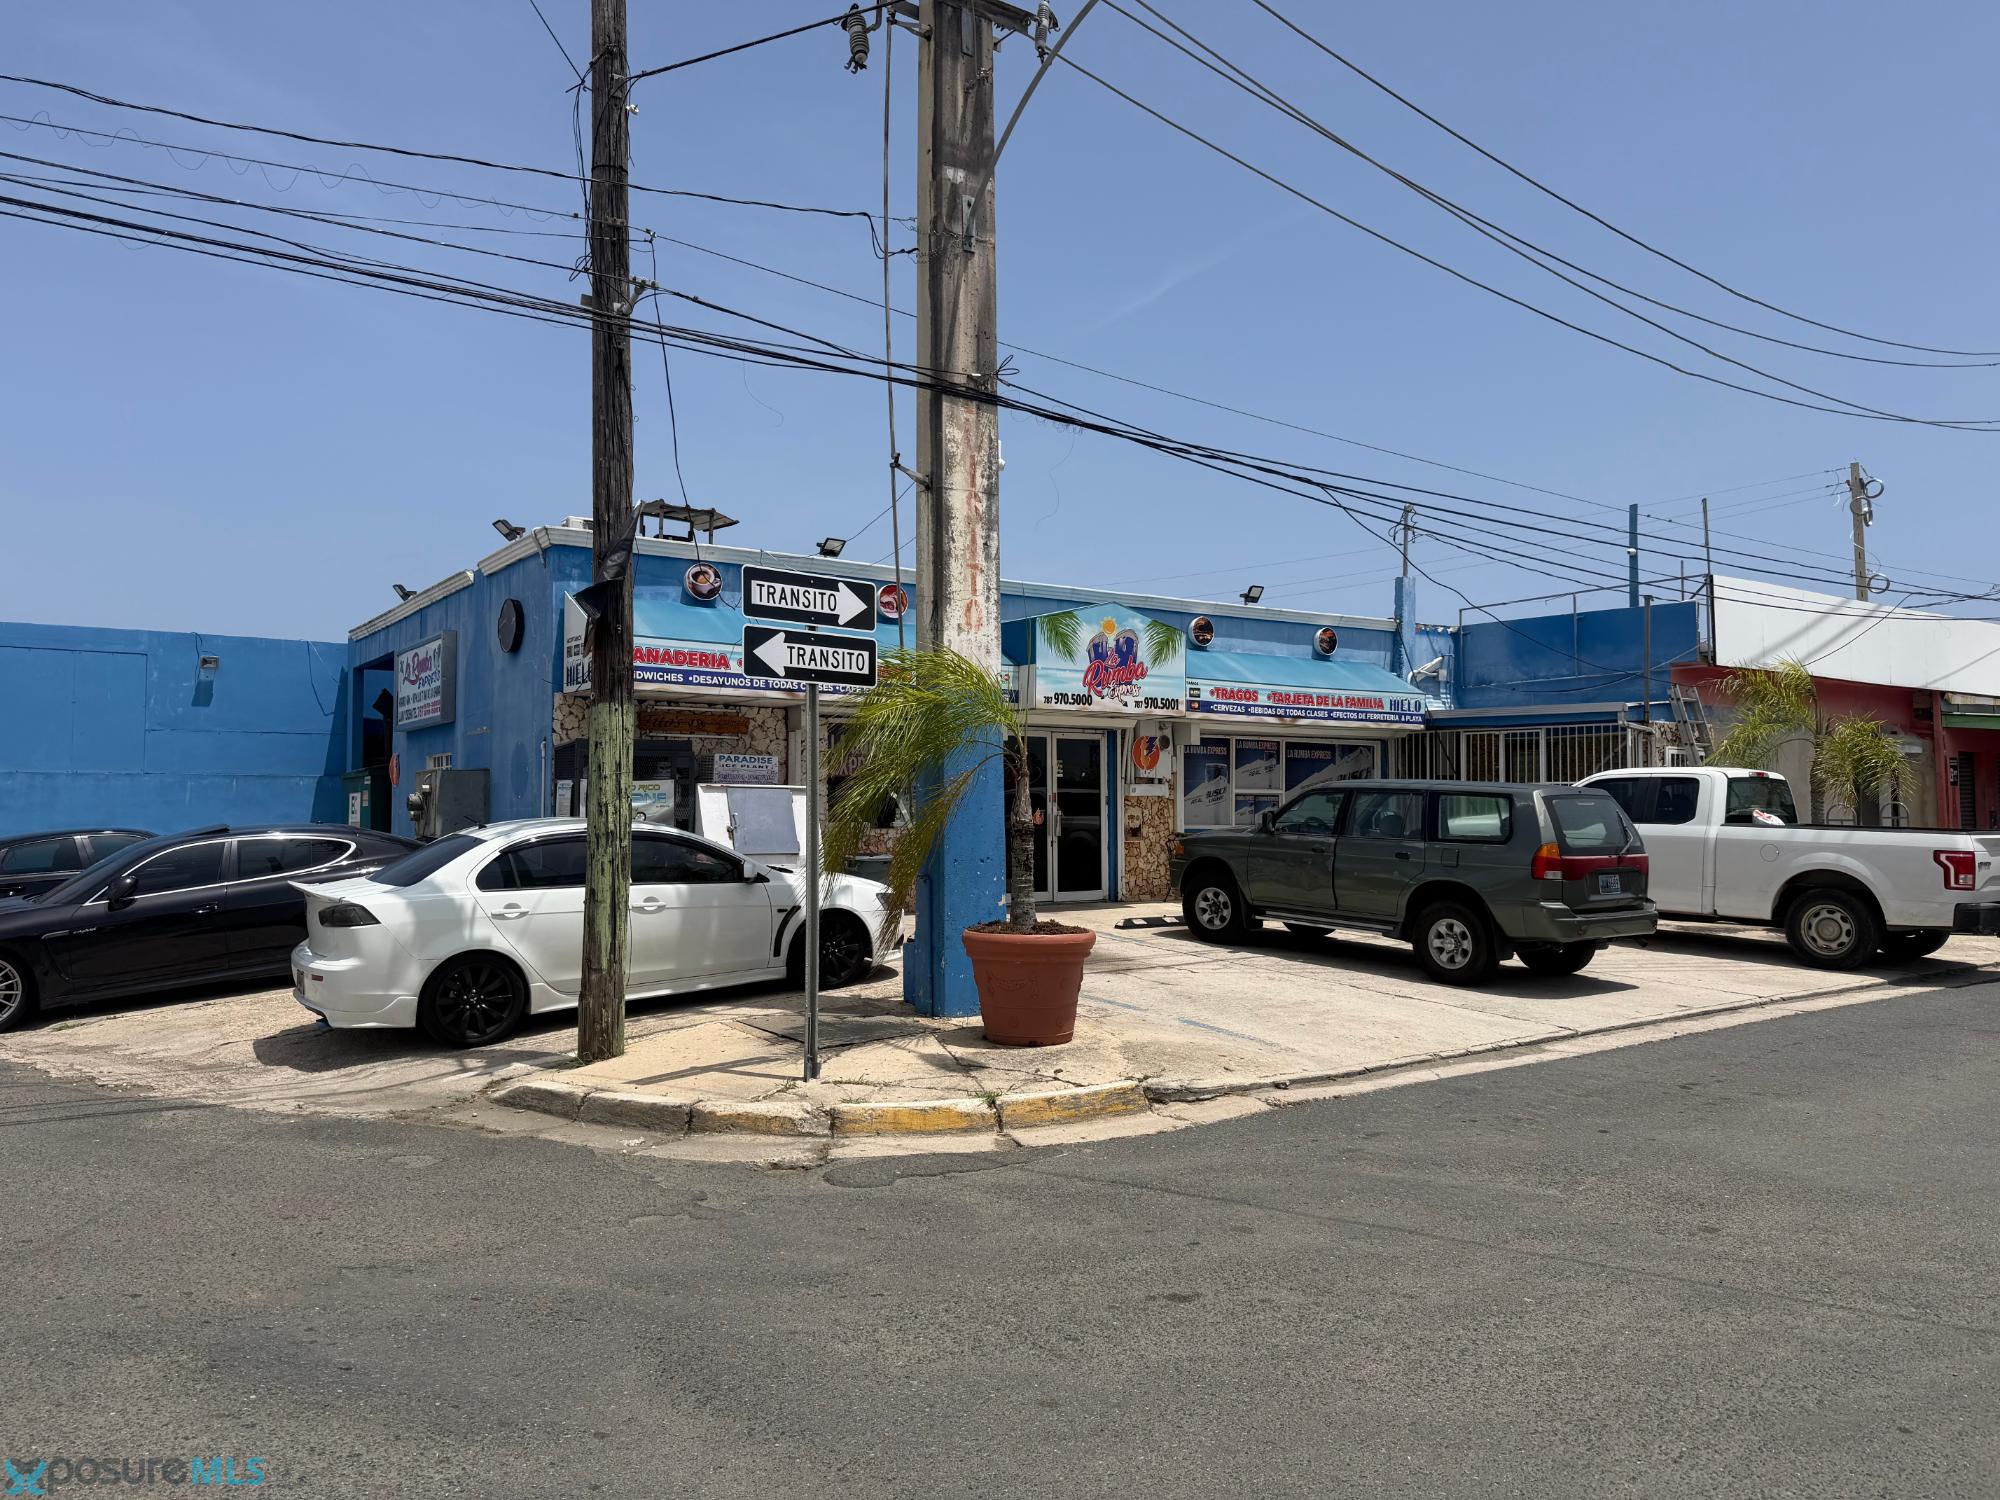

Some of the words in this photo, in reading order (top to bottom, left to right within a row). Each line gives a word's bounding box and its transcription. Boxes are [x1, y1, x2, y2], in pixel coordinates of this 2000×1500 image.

[756, 583, 837, 612] TRANSITO
[632, 646, 732, 671] ANADERIA
[787, 645, 865, 671] TRANSITO
[633, 670, 684, 682] DWICHES
[753, 679, 766, 687] DE
[767, 680, 798, 690] TODAS
[800, 682, 834, 692] CSES
[1082, 655, 1149, 698] Rumba
[1043, 696, 1053, 704] 787
[1053, 692, 1093, 706] 970.5000
[1134, 700, 1143, 709] 787
[1144, 696, 1179, 710] 970.5001
[1316, 694, 1330, 708] DE
[1331, 695, 1344, 708] LA
[1344, 696, 1385, 710] FAMILIA
[1389, 696, 1422, 712] HIELO
[1276, 708, 1285, 716] DE
[1286, 708, 1305, 717] TODAS
[1306, 709, 1328, 718] CLASES
[1358, 712, 1366, 720] DE
[718, 754, 774, 765] PARADISE
[638, 783, 661, 791] RICO
